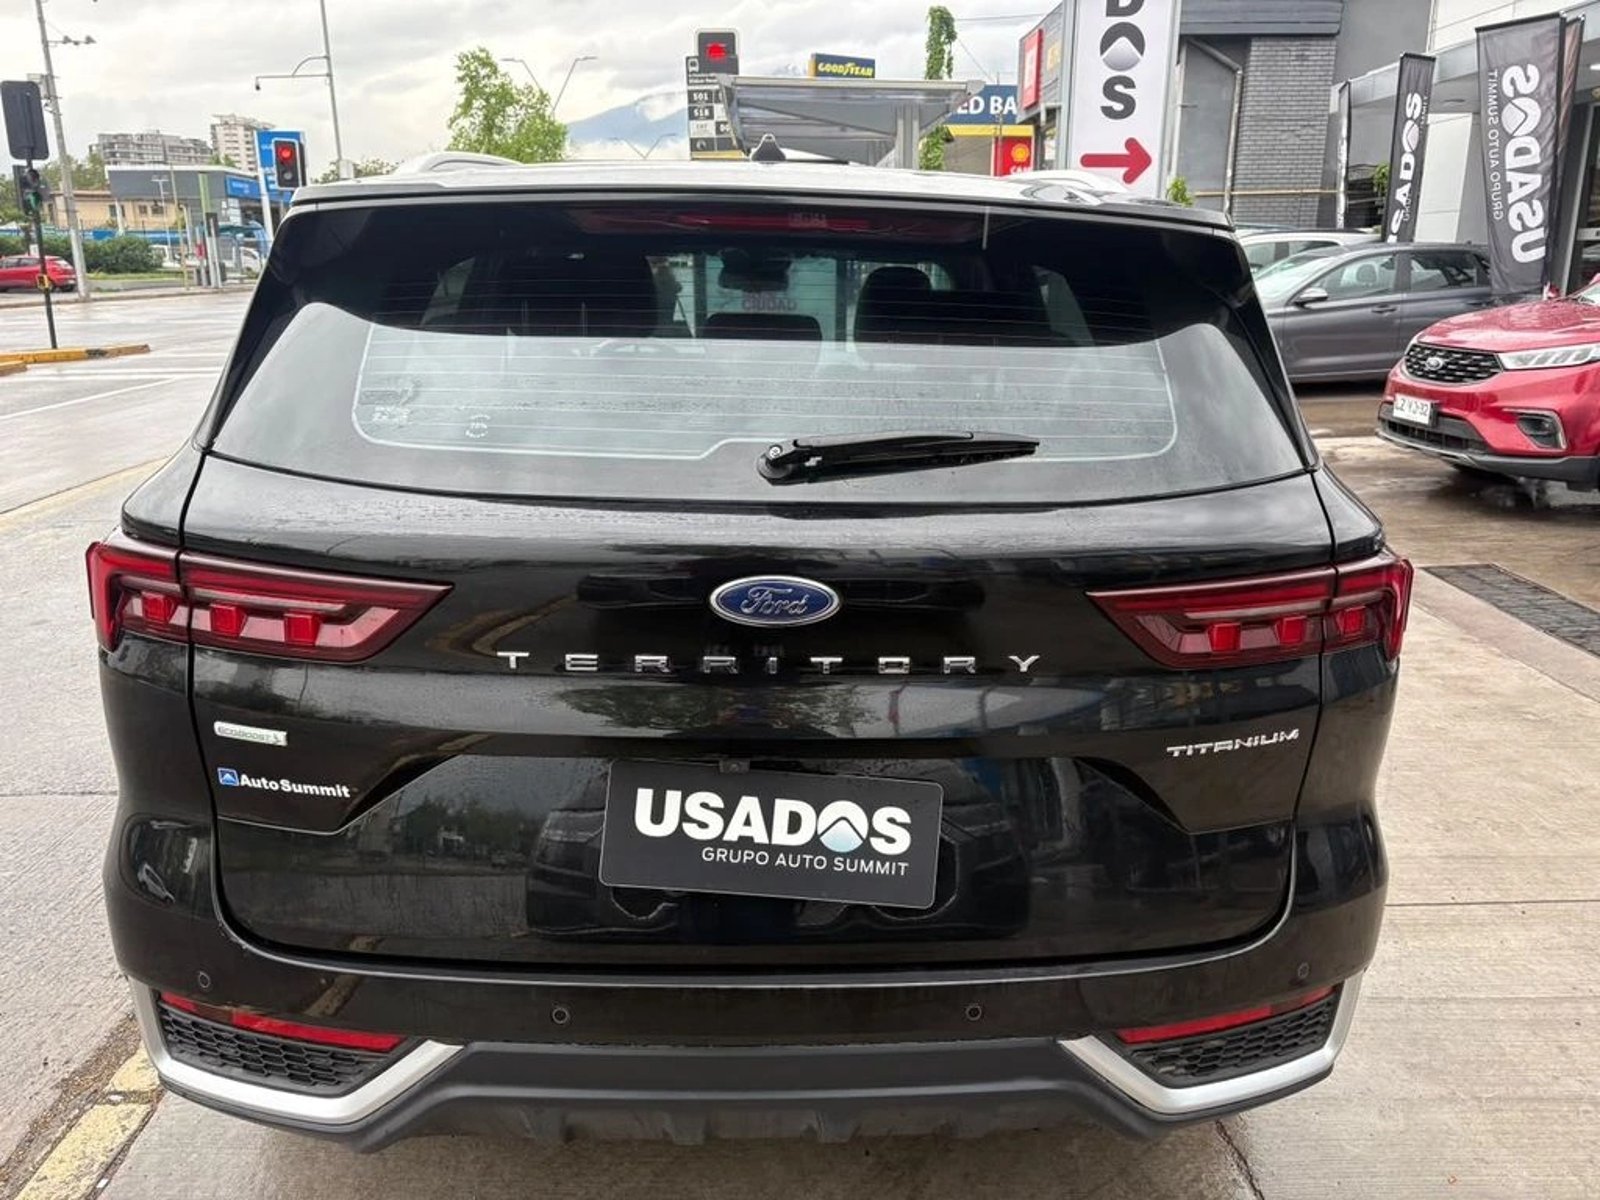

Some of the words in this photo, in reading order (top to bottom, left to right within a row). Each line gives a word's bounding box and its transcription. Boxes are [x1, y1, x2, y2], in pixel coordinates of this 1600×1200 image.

[740, 586, 810, 614] Ford
[497, 651, 1040, 675] TERRITORY
[1166, 728, 1299, 757] TITANIUM
[634, 787, 912, 856] USADOS
[701, 846, 770, 866] GRUPO
[775, 853, 828, 871] AUTO
[833, 857, 910, 877] SUMMIT
